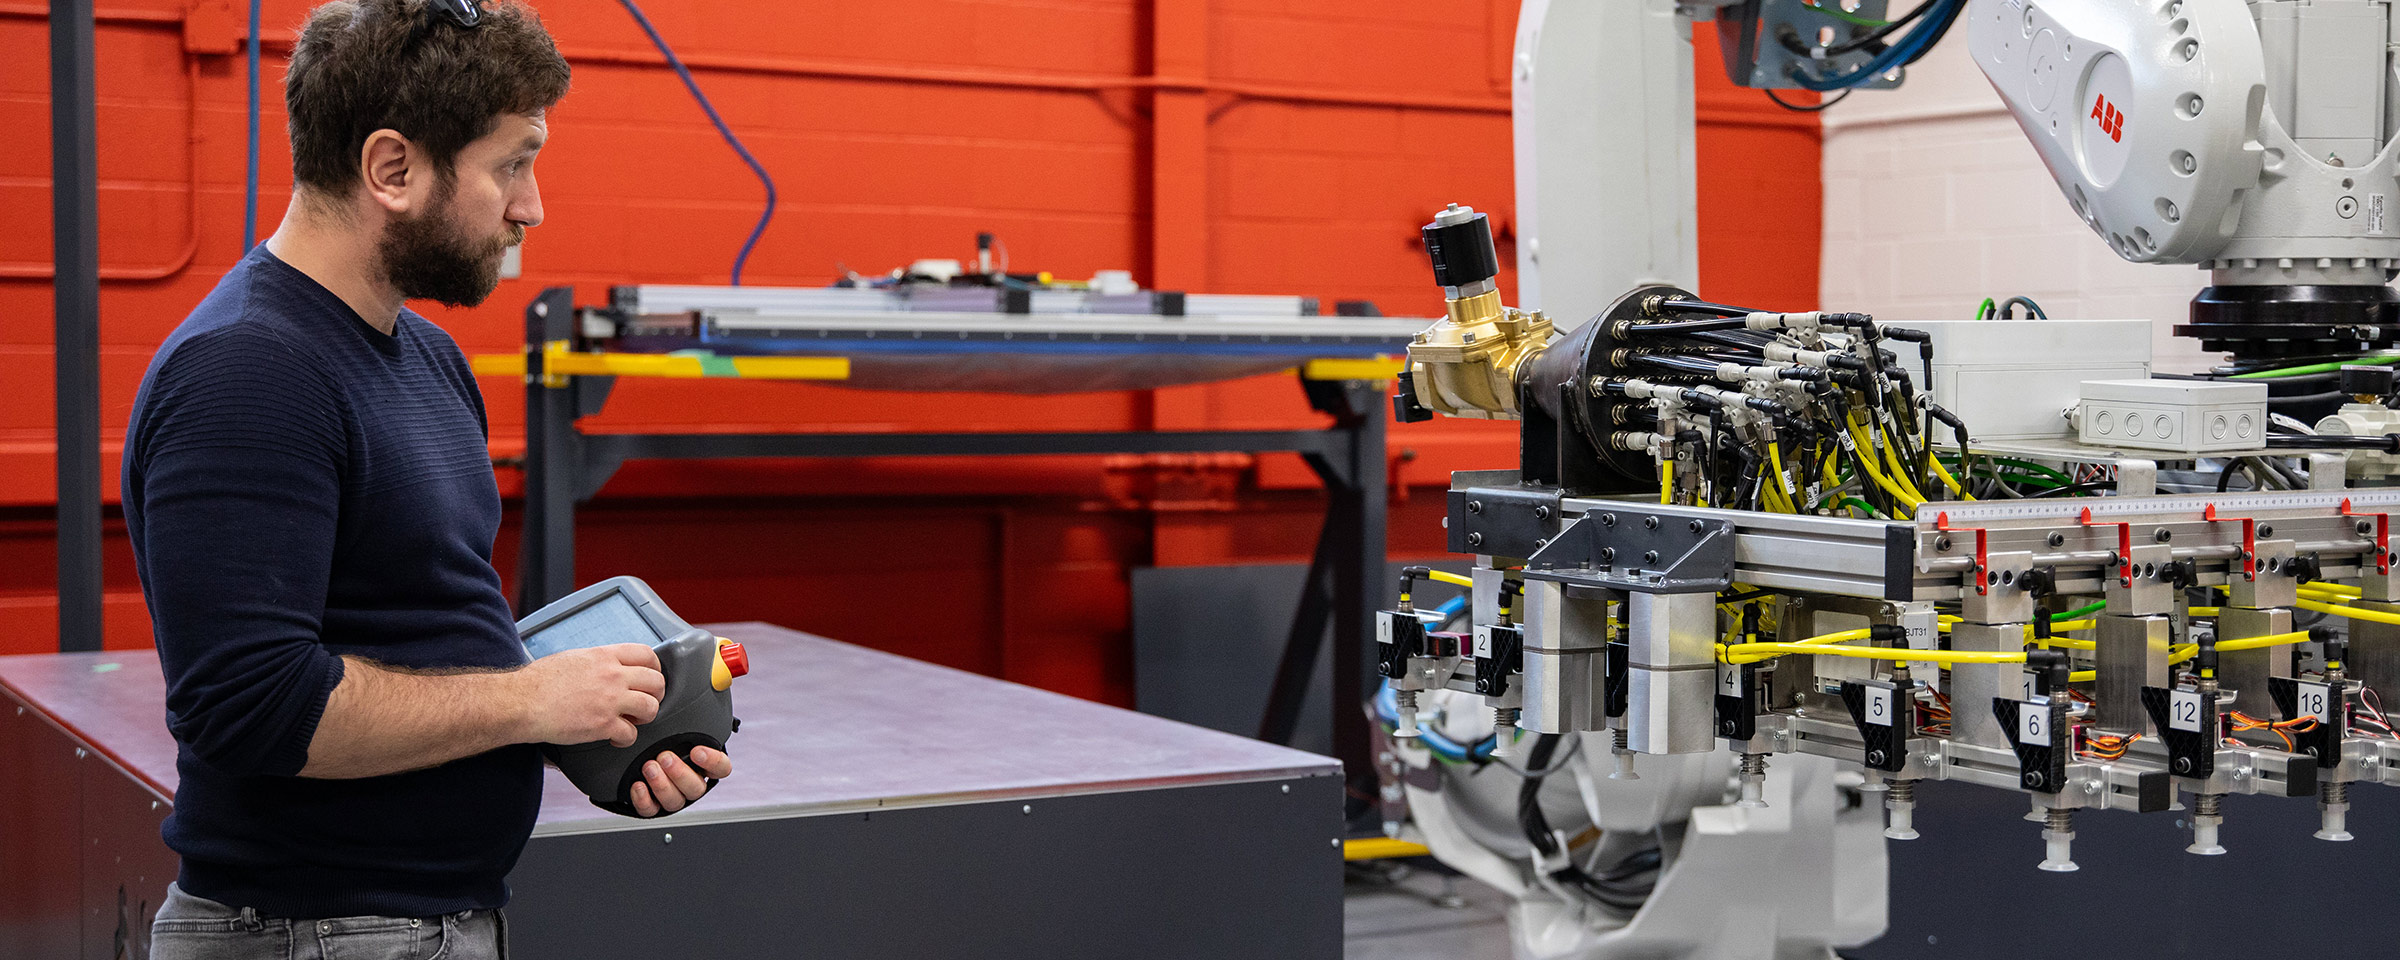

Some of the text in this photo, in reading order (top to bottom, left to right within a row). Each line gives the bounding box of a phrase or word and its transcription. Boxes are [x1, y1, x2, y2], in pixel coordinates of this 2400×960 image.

[2090, 93, 2124, 143] ABB
[1382, 621, 1387, 636] 1
[1478, 634, 1486, 651] 2
[1725, 670, 1734, 689] 4
[1873, 696, 1883, 716] 5
[2173, 700, 2196, 723] 12
[2301, 692, 2323, 714] 18
[2028, 714, 2040, 736] 6
